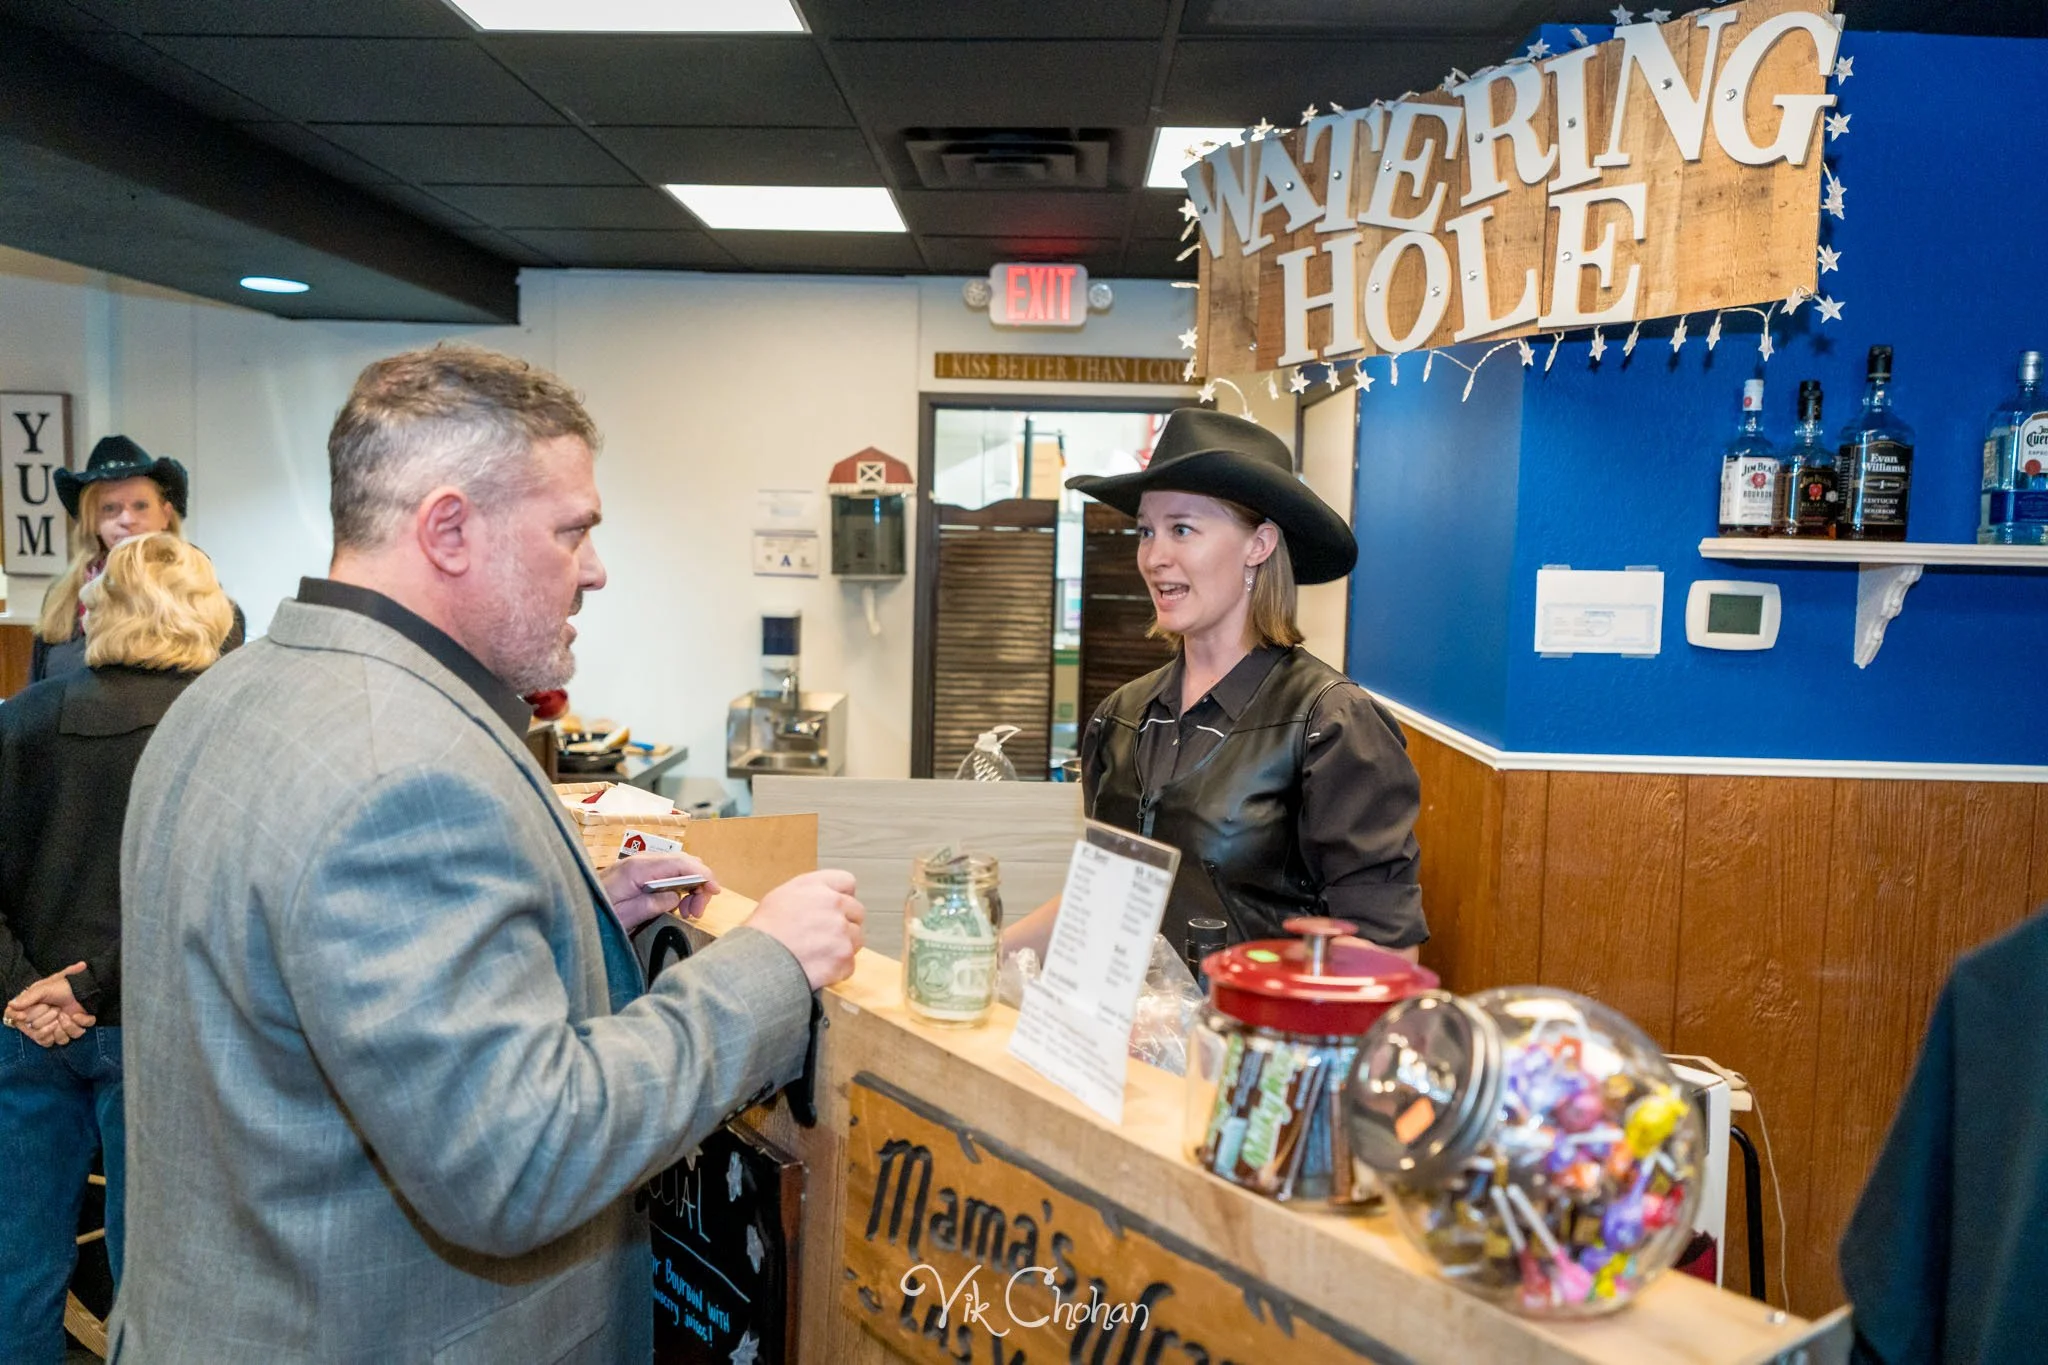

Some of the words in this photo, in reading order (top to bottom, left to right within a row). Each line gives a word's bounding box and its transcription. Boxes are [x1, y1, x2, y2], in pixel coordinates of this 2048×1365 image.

[1181, 9, 1846, 259] WATERING
[1005, 265, 1077, 321] EXIT
[1276, 183, 1647, 367] HOLE
[938, 356, 945, 377] I
[952, 356, 991, 378] KISS
[999, 357, 1067, 380] BETTER
[1076, 359, 1126, 382] THAN
[1134, 361, 1142, 382] I
[13, 411, 55, 556] YUM
[1741, 464, 1756, 476] JIM
[1864, 462, 1906, 473] Williams
[1870, 453, 1898, 463] Evan
[865, 1138, 1077, 1298] Mama's
